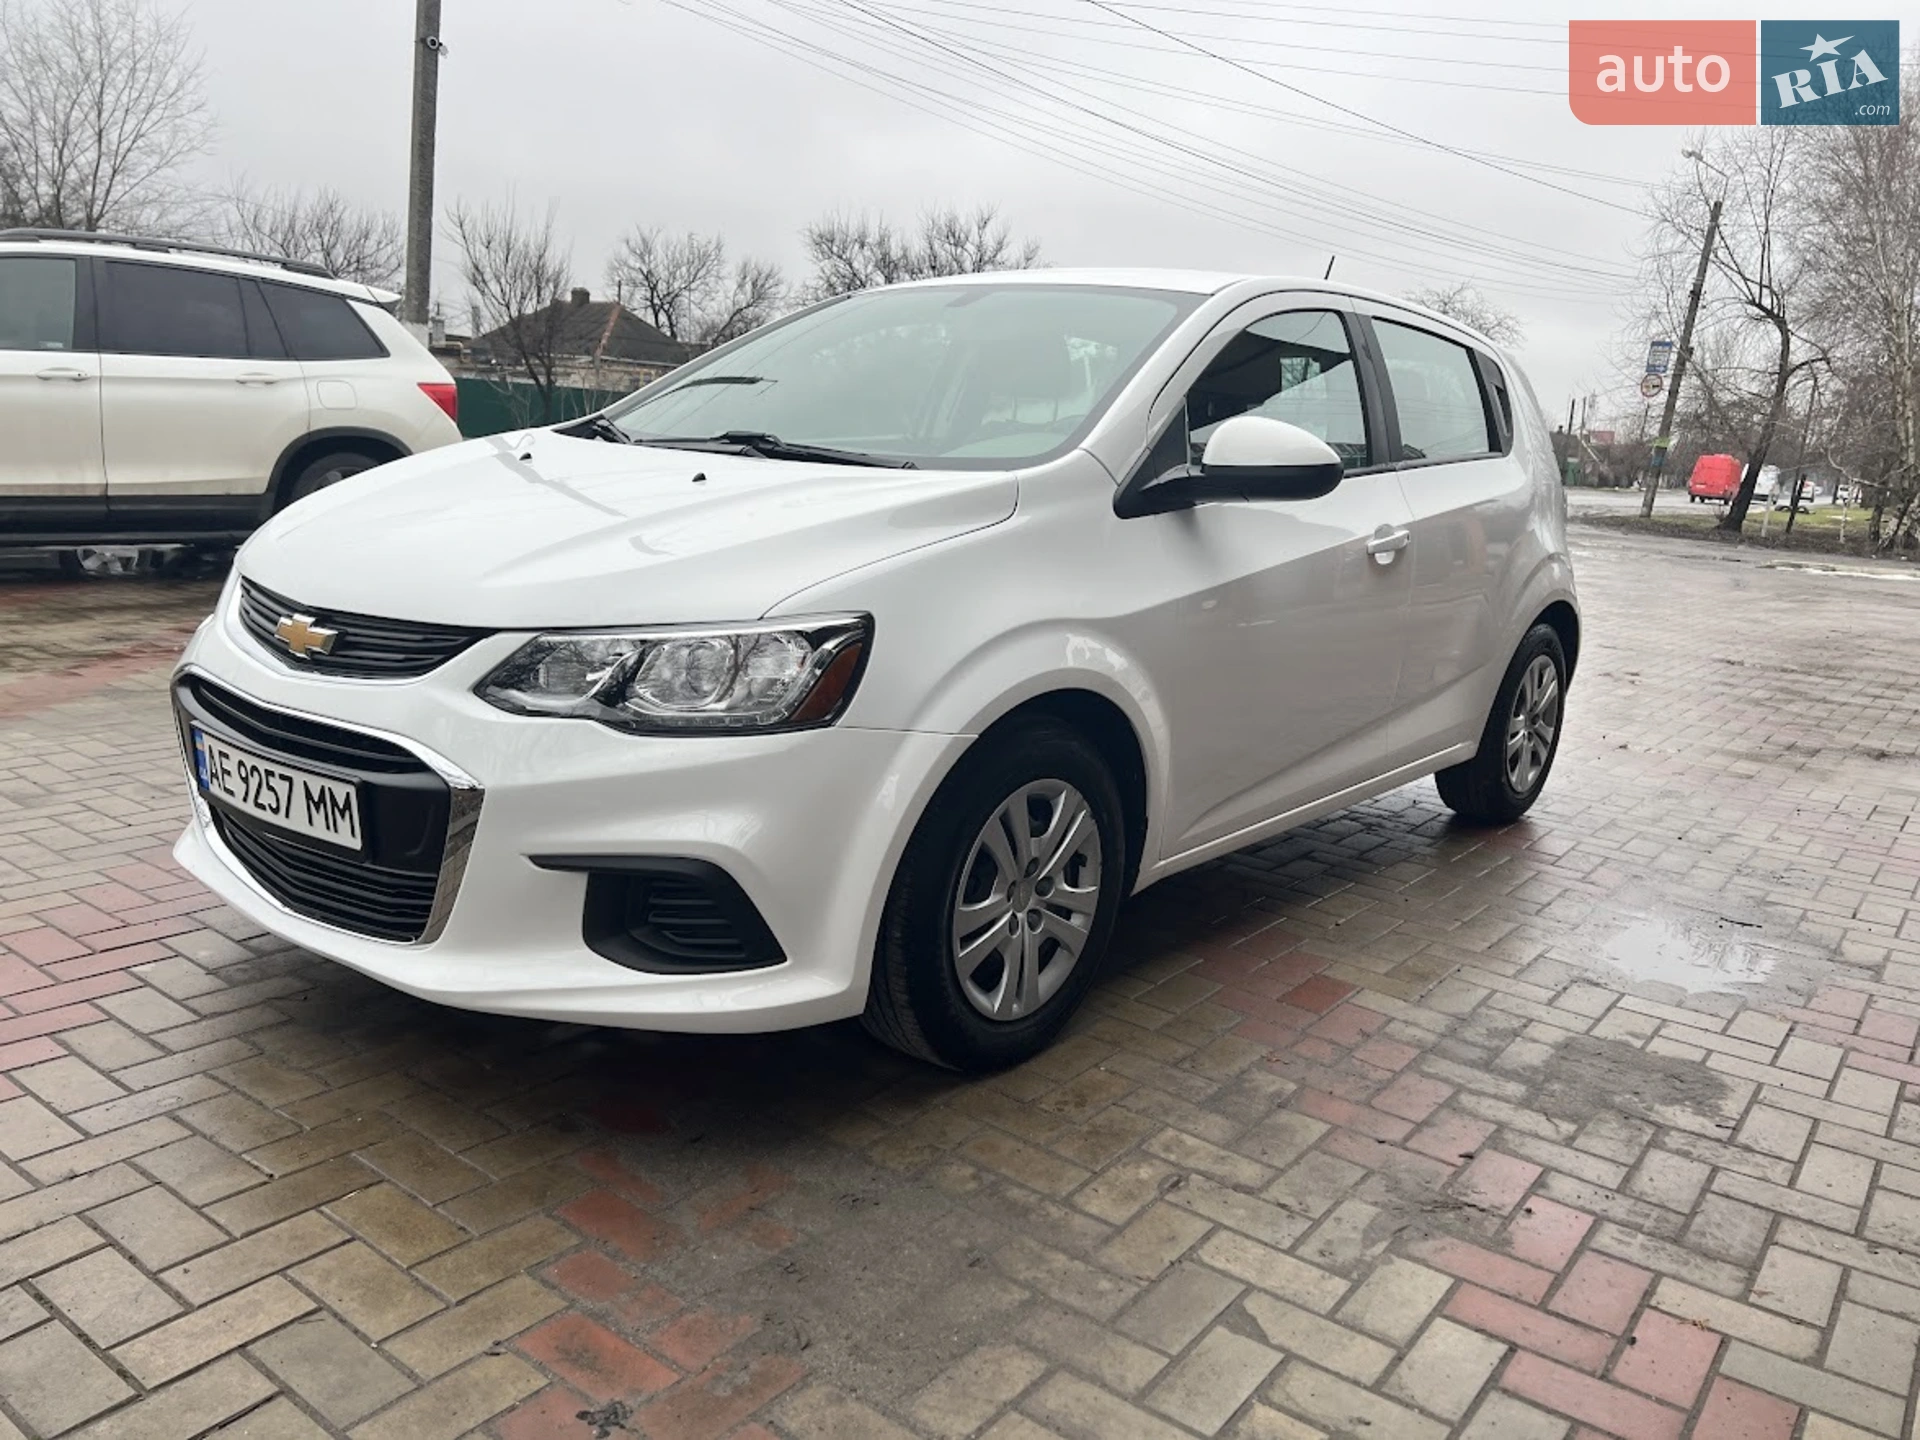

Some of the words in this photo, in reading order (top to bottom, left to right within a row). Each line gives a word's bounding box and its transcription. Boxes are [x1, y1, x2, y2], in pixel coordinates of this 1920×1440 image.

[208, 744, 236, 797] AE
[237, 759, 294, 819] 9257
[303, 780, 356, 838] MM
